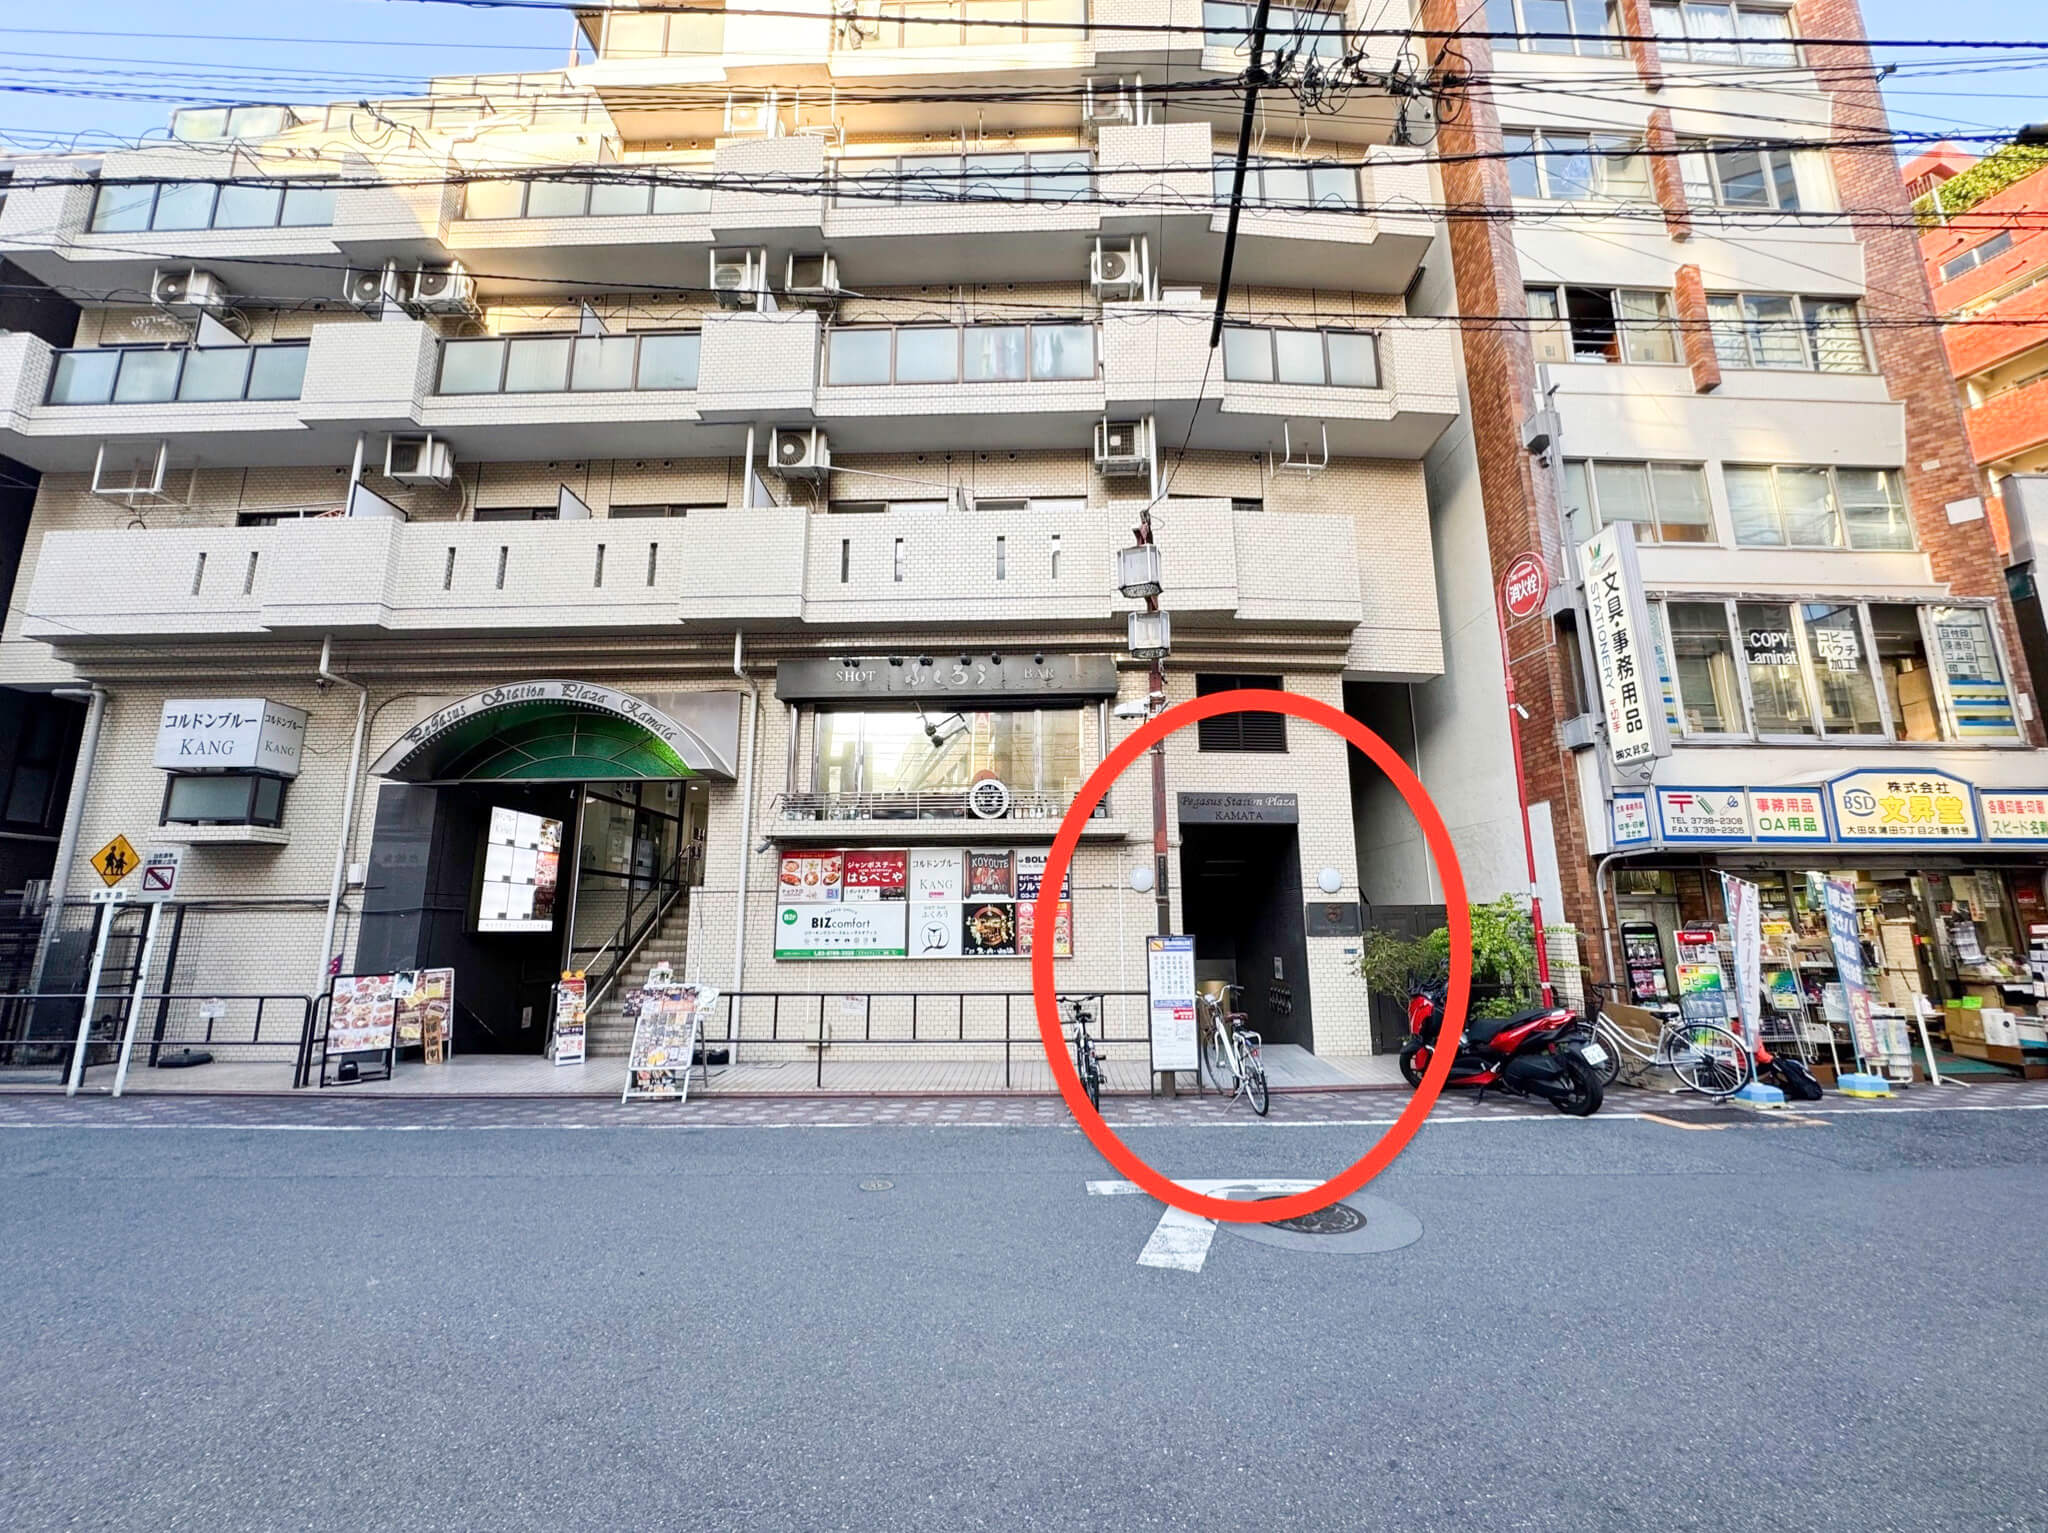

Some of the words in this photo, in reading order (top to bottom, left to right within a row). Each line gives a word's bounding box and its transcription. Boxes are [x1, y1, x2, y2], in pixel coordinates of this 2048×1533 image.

[1509, 574, 1538, 605] 消火栓
[1591, 582, 1616, 690] STATIONERY
[1750, 632, 1788, 648] COPY
[1819, 632, 1853, 643] コピー
[1602, 571, 1643, 734] 文具・事務用品
[1831, 658, 1857, 670] 加工
[835, 670, 876, 682] SHOT
[1024, 668, 1055, 680] BAR
[165, 712, 257, 729] コルドンブルー
[404, 704, 467, 745] Pegasus
[481, 685, 546, 706] Station
[560, 683, 609, 704] Plaza
[620, 699, 677, 741] Kamata
[264, 714, 303, 730] コルドンブルー
[179, 738, 235, 755] KANG
[264, 740, 296, 756] KANG
[1887, 781, 1951, 794] 株式会社
[1182, 796, 1222, 809] Pegasus
[1224, 796, 1263, 807] Station
[1265, 796, 1296, 807] Plaza
[1756, 798, 1815, 813] 事務用品
[1843, 796, 1876, 810] BSD
[1215, 811, 1263, 820] KAMATA
[1879, 796, 1965, 824] 文昇堂
[1671, 817, 1687, 825] TEL
[1759, 818, 1818, 832] OA用品
[912, 859, 960, 868] コルドンブルー
[920, 879, 952, 890] KANG
[811, 914, 870, 929] BIZcomfort
